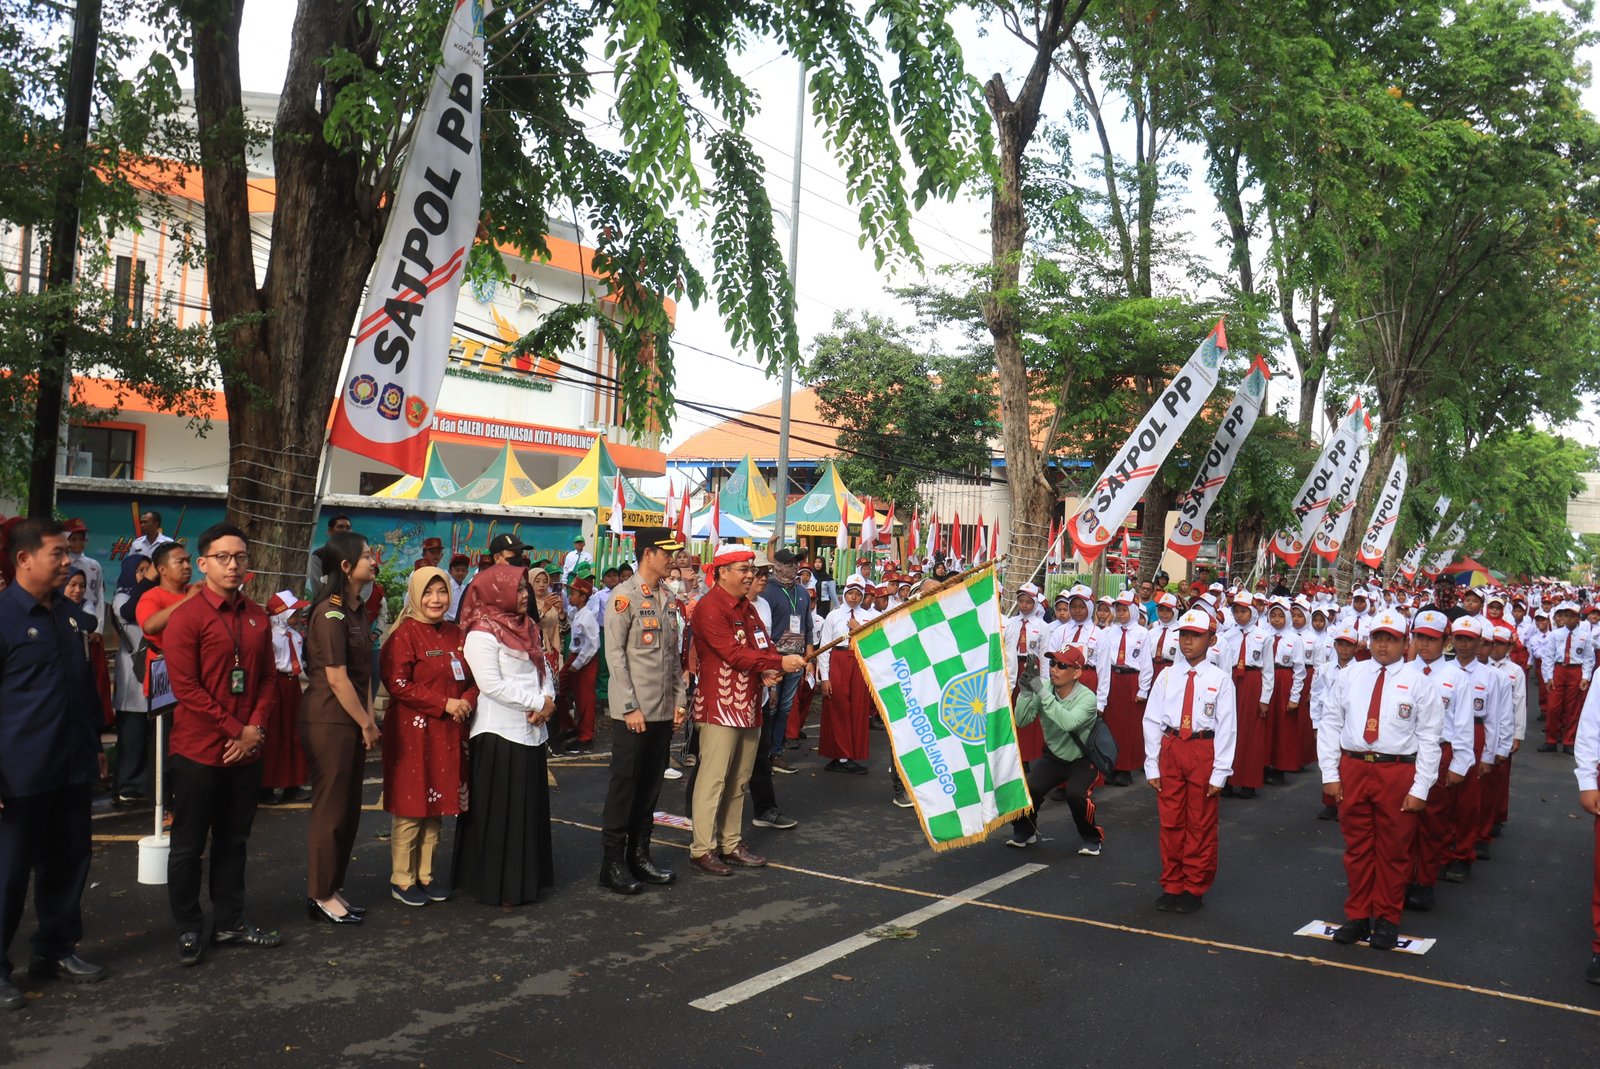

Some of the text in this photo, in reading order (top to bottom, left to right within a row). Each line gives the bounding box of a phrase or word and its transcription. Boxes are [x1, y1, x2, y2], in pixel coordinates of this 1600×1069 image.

[374, 72, 474, 375] SATPOL PP
[439, 417, 456, 433] dan
[457, 419, 484, 437] GALERI
[485, 423, 534, 443] DEKRANASDA
[534, 429, 552, 445] KOTA
[552, 432, 595, 450] PROBOLINGG
[1097, 375, 1193, 513] SATPOL PP
[1182, 404, 1244, 520] SATPOL PP
[628, 513, 645, 523] KOTA
[1292, 439, 1347, 532] ATPOL PP
[1324, 476, 1355, 534] SAPOL
[1348, 446, 1362, 474] PP
[1367, 470, 1402, 543] SATPOL PP
[890, 657, 957, 796] KOTA PROBOLINGGO
